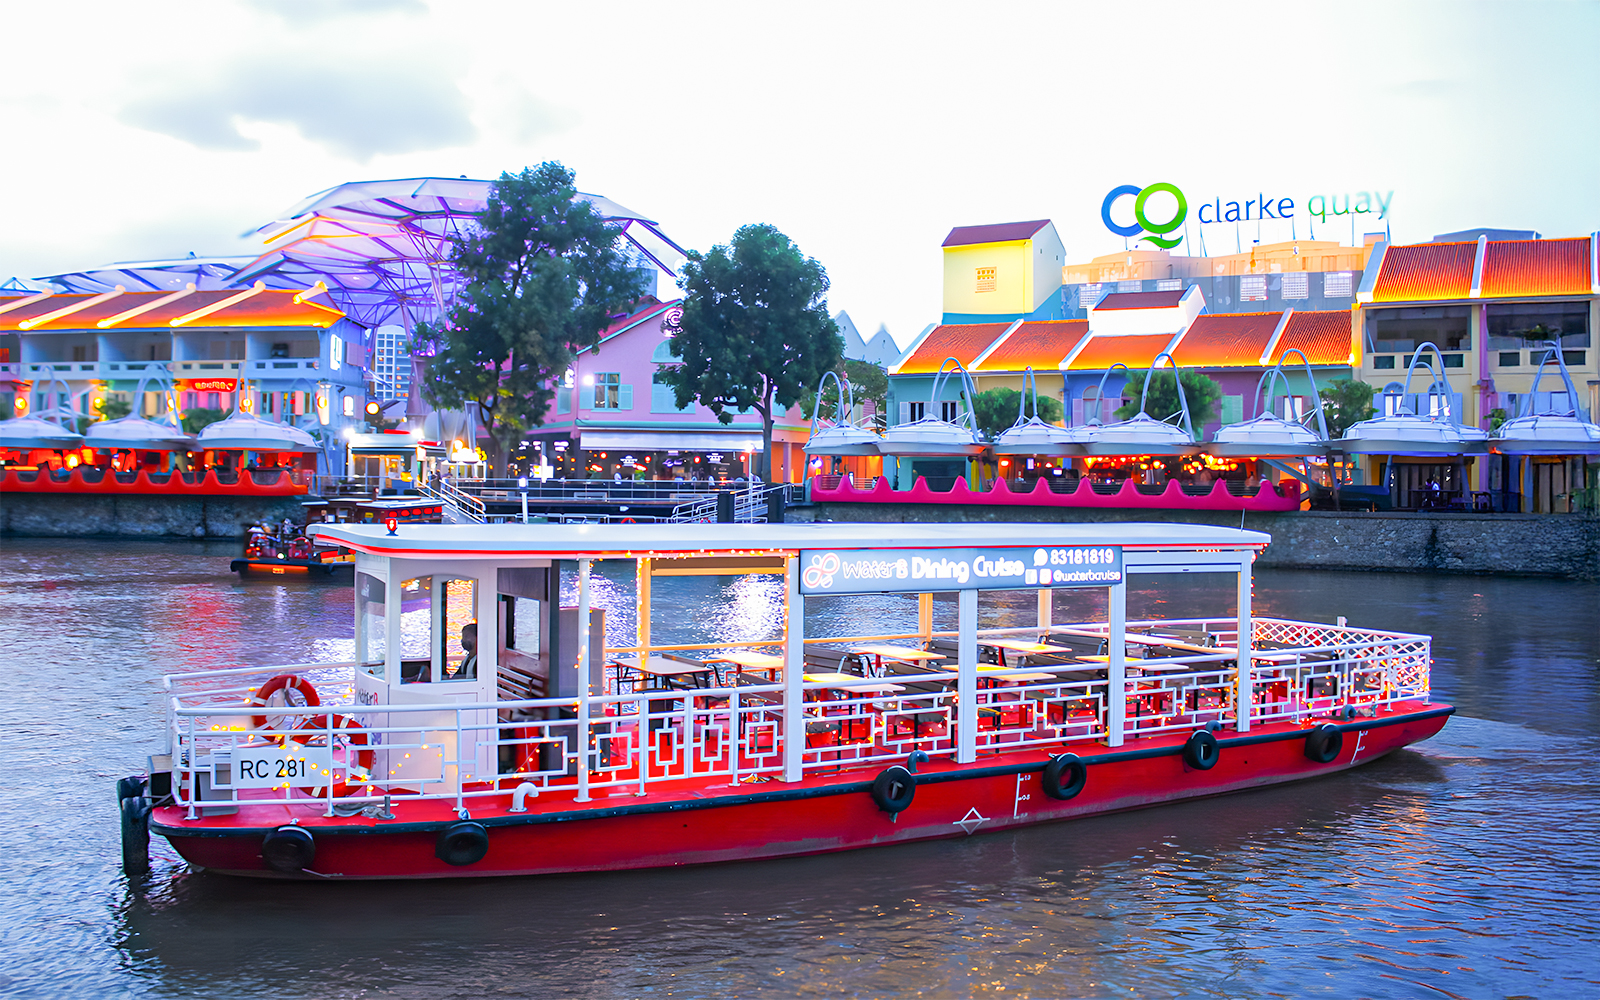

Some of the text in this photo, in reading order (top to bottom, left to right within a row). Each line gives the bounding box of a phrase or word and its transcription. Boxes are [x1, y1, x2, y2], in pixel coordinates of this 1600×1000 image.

[1198, 189, 1394, 224] clarke quay
[912, 556, 970, 584] Dining
[973, 555, 1026, 578] Cruise
[1050, 548, 1115, 566] 83181819
[240, 759, 305, 780] RC 281
